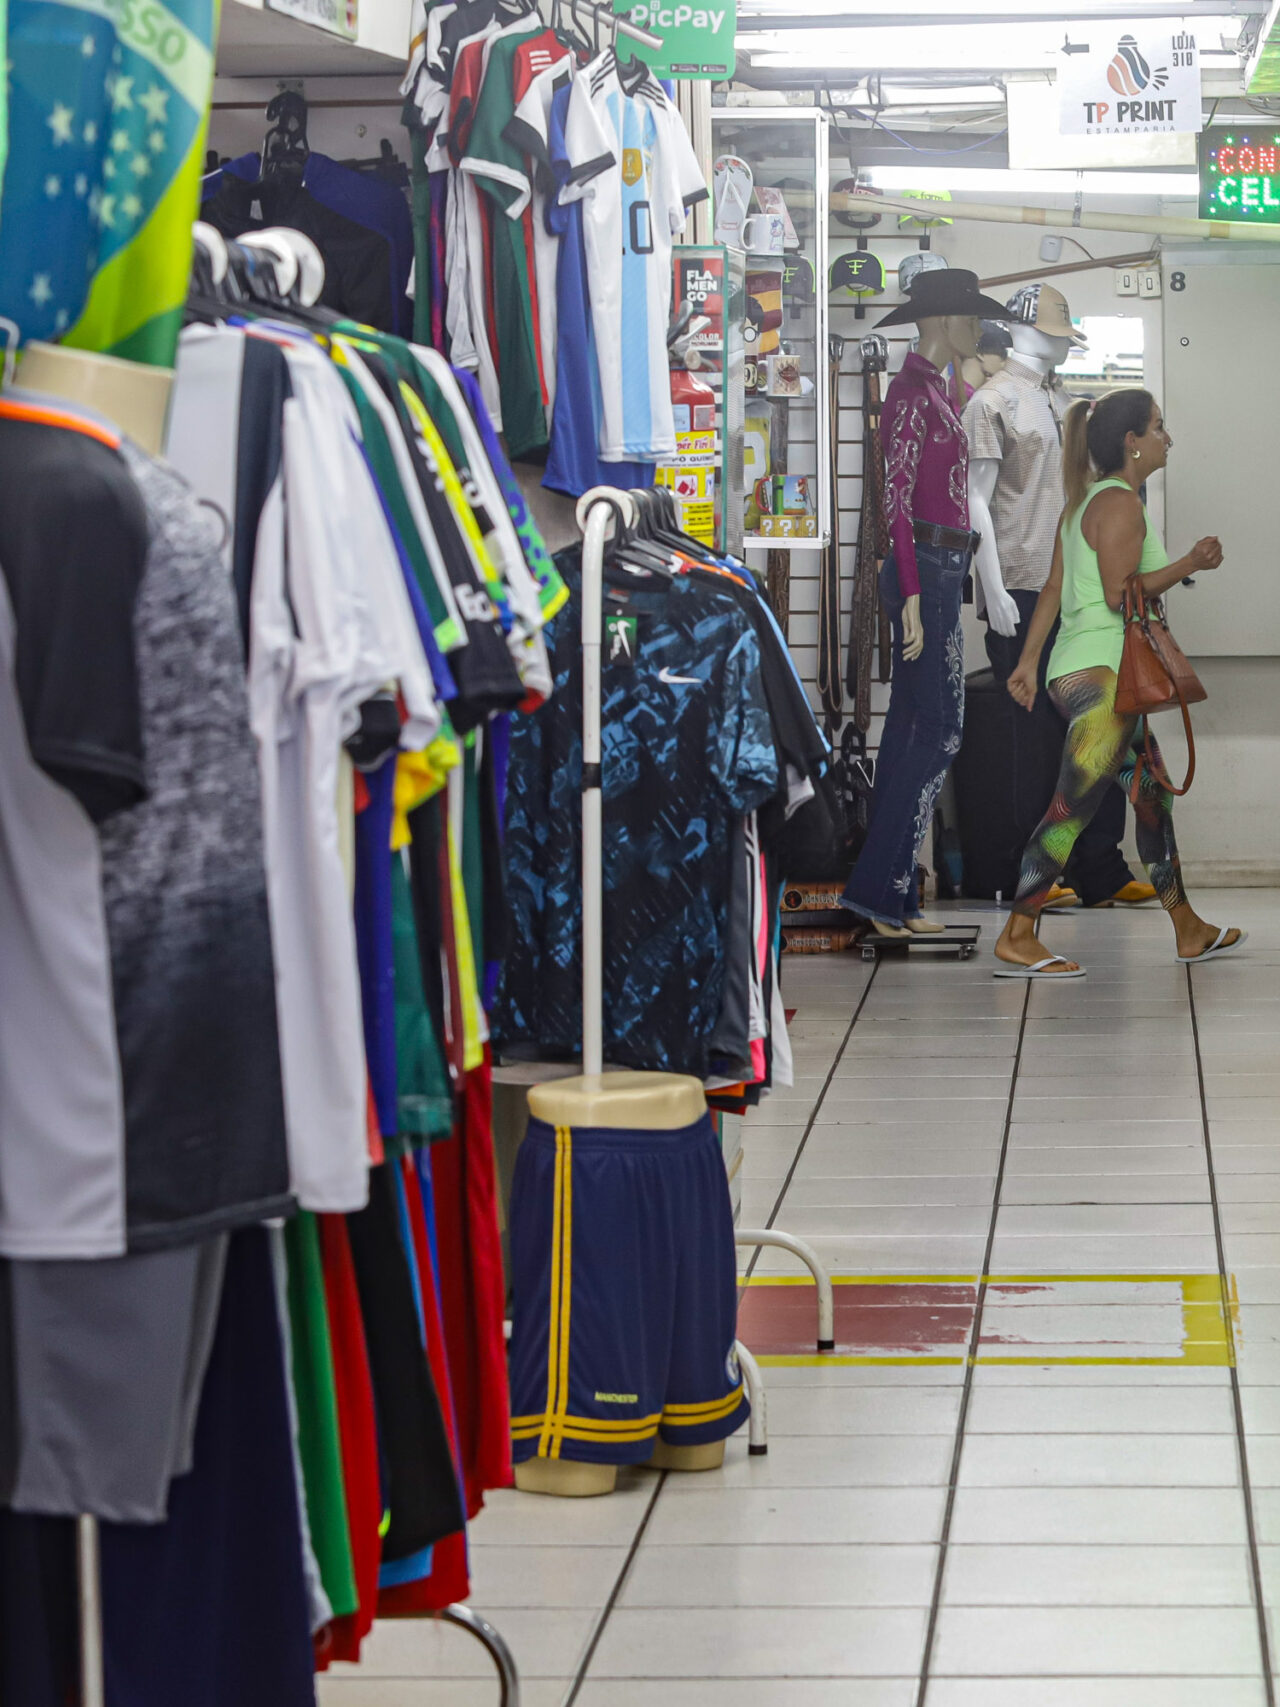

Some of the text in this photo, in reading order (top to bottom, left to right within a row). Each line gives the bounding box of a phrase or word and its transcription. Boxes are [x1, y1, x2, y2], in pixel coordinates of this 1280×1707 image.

[630, 0, 726, 34] PicPay
[1171, 35, 1196, 50] LOJA
[1172, 52, 1193, 67] 310
[1083, 99, 1177, 123] TP PRINT
[1086, 125, 1176, 134] ESTAMPARIA
[686, 269, 713, 281] FLA
[1169, 271, 1186, 292] 8
[686, 280, 718, 292] MEN
[686, 291, 708, 302] GO
